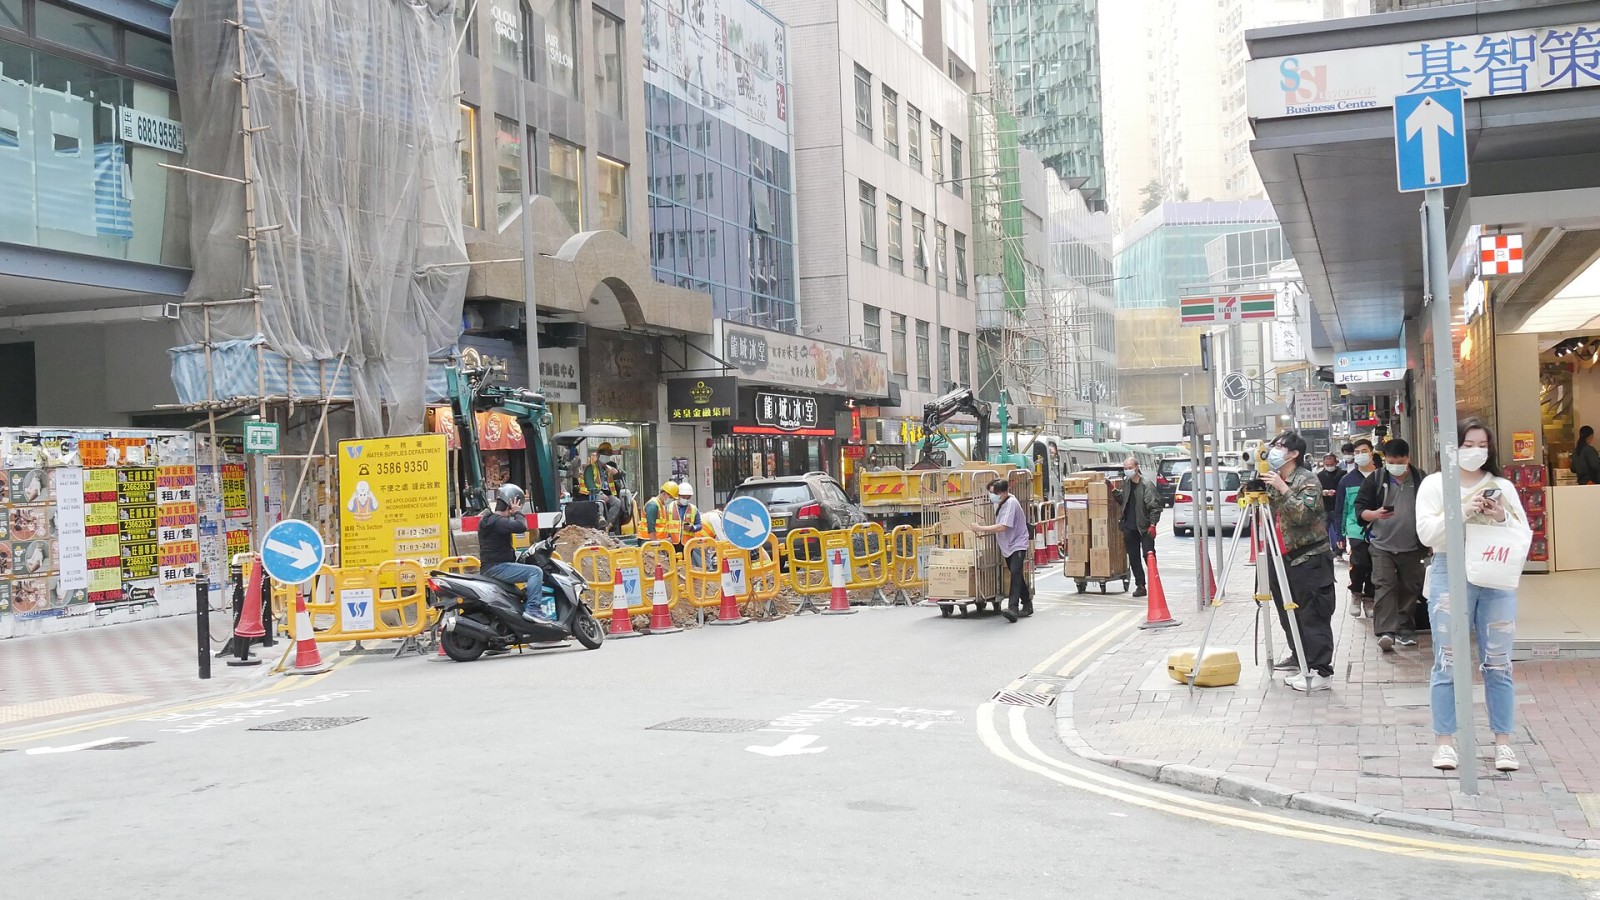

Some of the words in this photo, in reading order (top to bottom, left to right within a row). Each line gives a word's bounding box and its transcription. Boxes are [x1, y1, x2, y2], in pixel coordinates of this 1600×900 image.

[1406, 26, 1600, 95] 基智策
[1286, 104, 1336, 115] Business
[1337, 100, 1377, 110] Centre
[125, 112, 132, 138] 出租
[730, 334, 766, 362] 龍城冰室
[673, 407, 731, 418] 英皇金融集團
[764, 395, 814, 422] 龍城冰室
[384, 449, 408, 457] SUPPLIES
[408, 447, 441, 456] DEPARTMENT
[377, 462, 401, 475] 3586
[404, 460, 429, 473] 9350
[158, 476, 177, 487] 2391
[178, 475, 192, 486] 8028
[161, 489, 191, 501] 租/售
[160, 516, 178, 527] 2391
[179, 515, 195, 526] 8028
[163, 528, 193, 541] 租/售
[161, 555, 178, 566] 2391
[180, 554, 197, 564] 8028
[1481, 545, 1510, 563] H&M
[164, 567, 195, 580] 租/售
